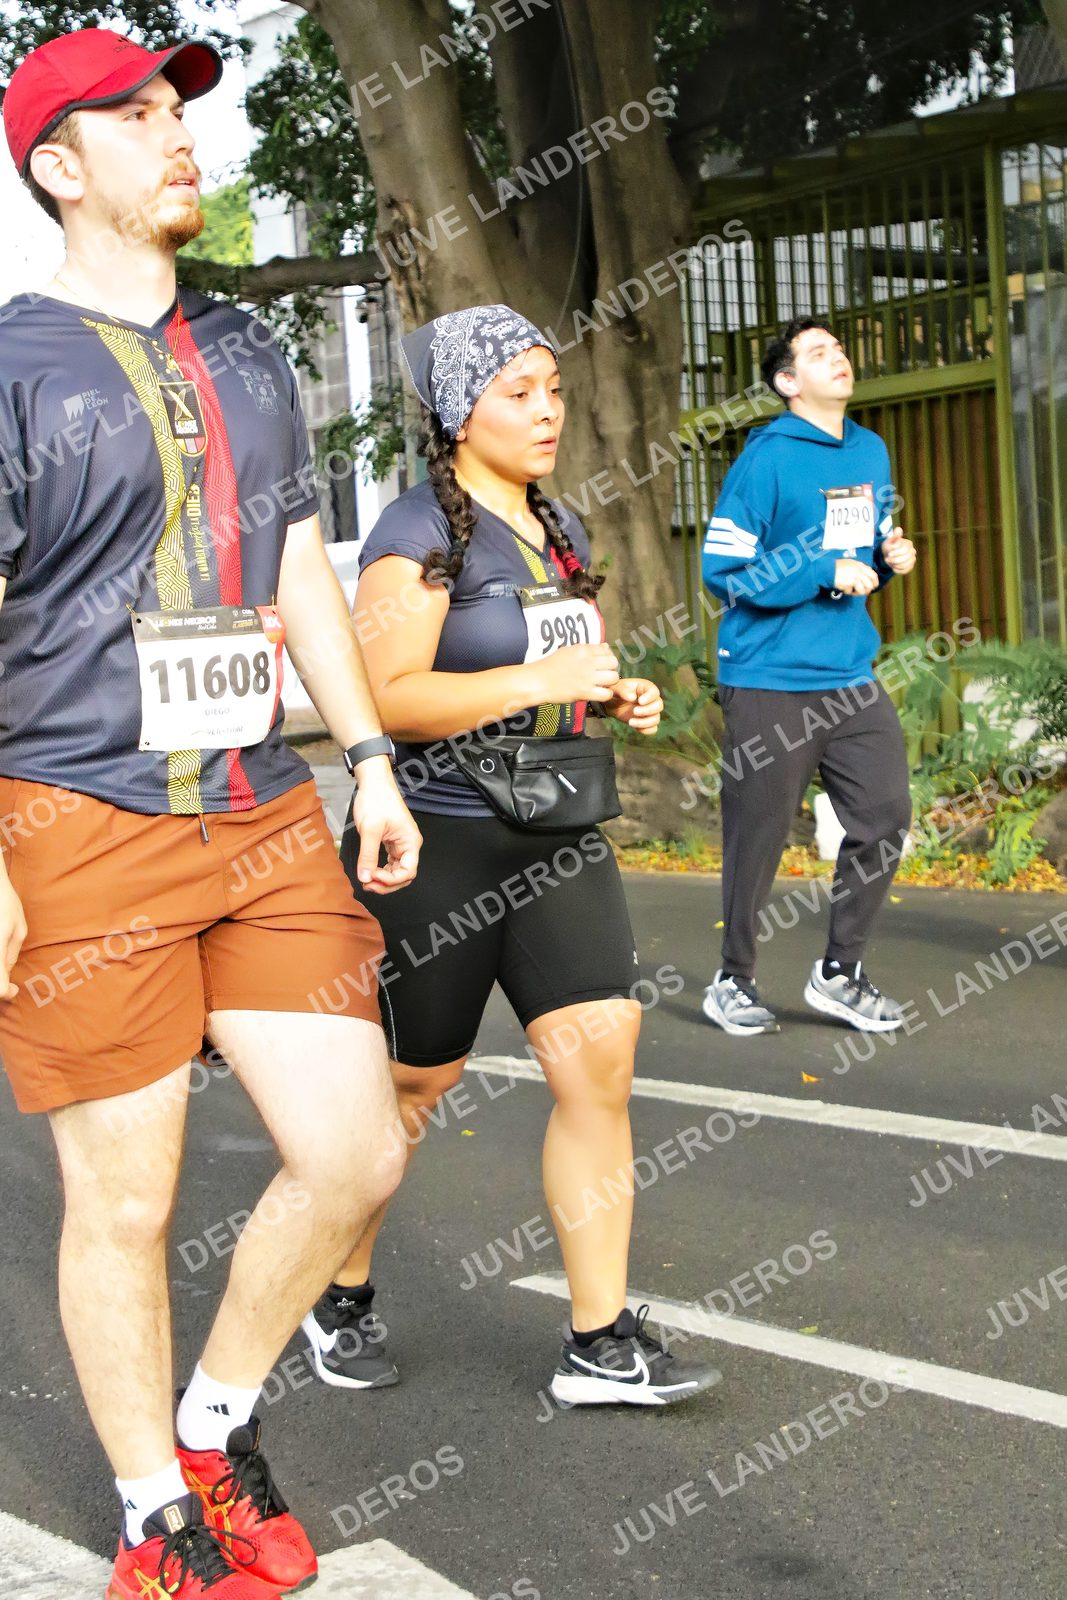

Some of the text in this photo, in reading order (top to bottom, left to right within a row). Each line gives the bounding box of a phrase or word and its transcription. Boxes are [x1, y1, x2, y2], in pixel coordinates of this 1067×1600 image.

[831, 506, 871, 527] 10290
[540, 612, 590, 655] 9981
[149, 650, 271, 704] 11608
